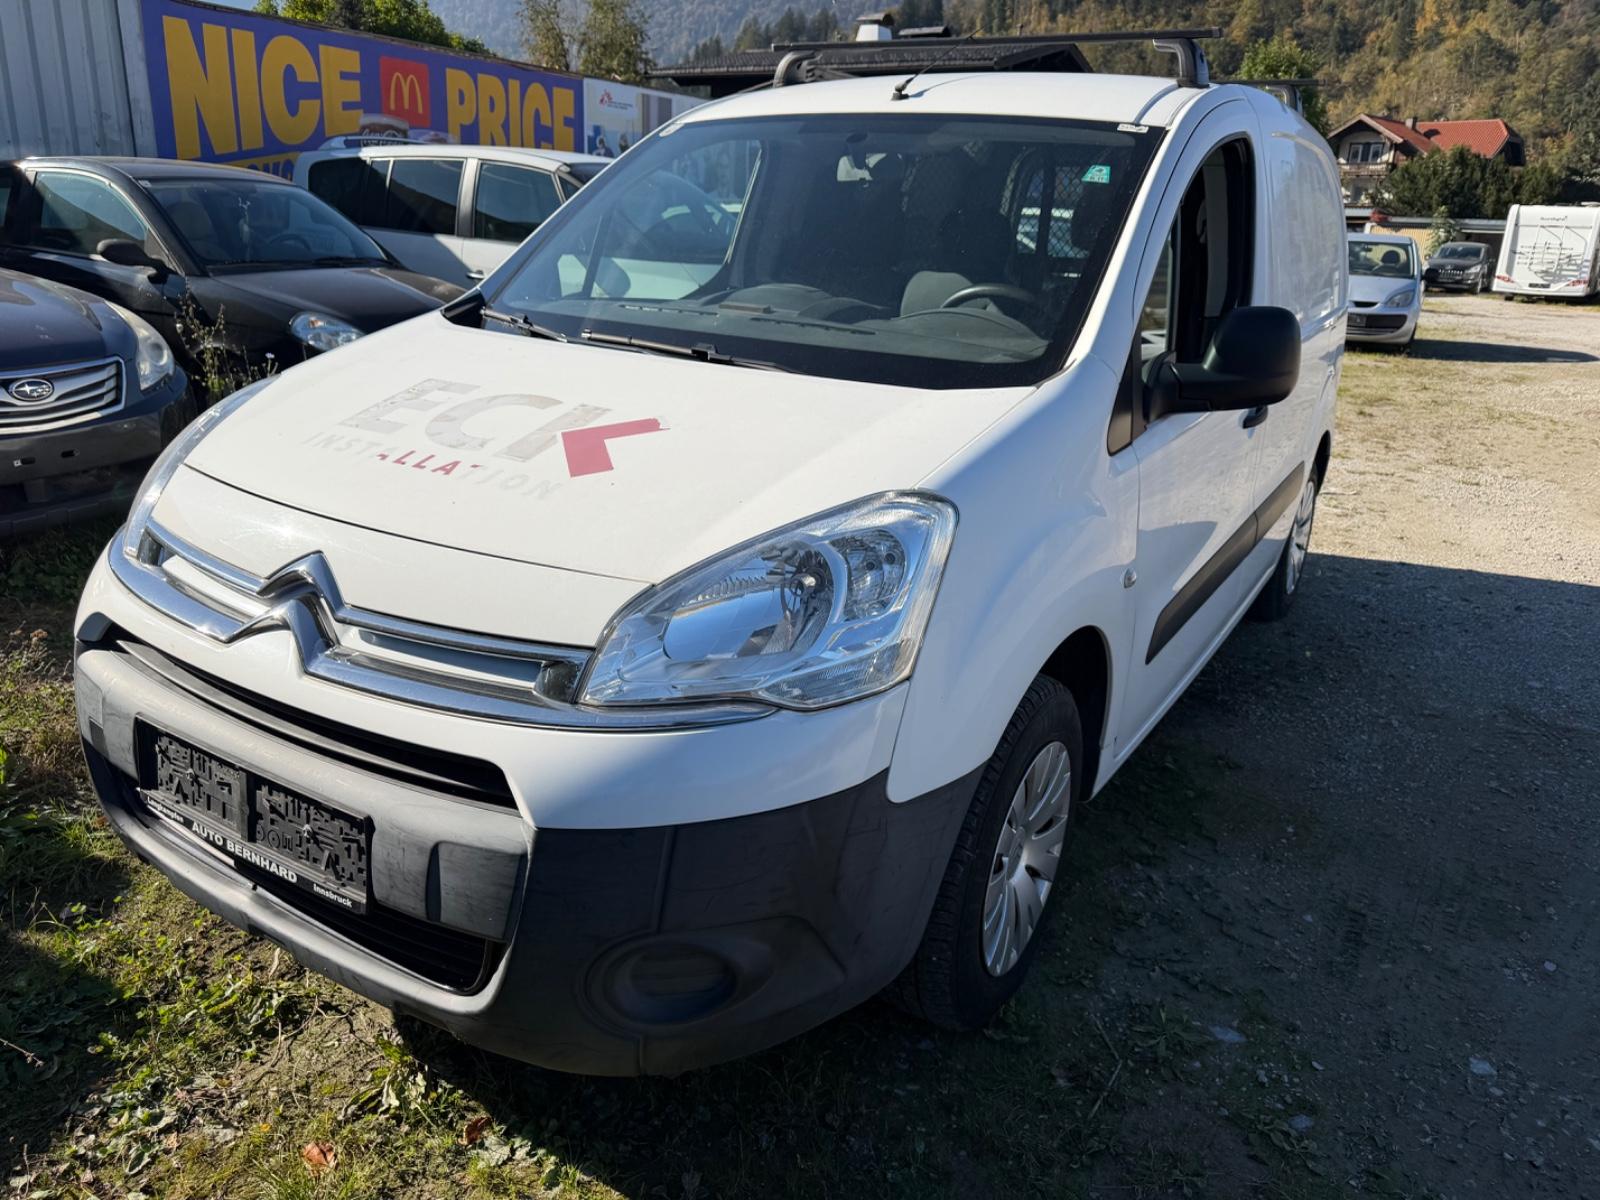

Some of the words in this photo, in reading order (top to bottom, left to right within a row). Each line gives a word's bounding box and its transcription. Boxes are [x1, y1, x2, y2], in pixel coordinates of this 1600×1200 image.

[163, 15, 363, 161] NICE
[446, 67, 577, 152] PRICE
[191, 820, 223, 847] AUTO
[226, 838, 298, 884] BERNHARD
[313, 883, 352, 908] Innsbruck
